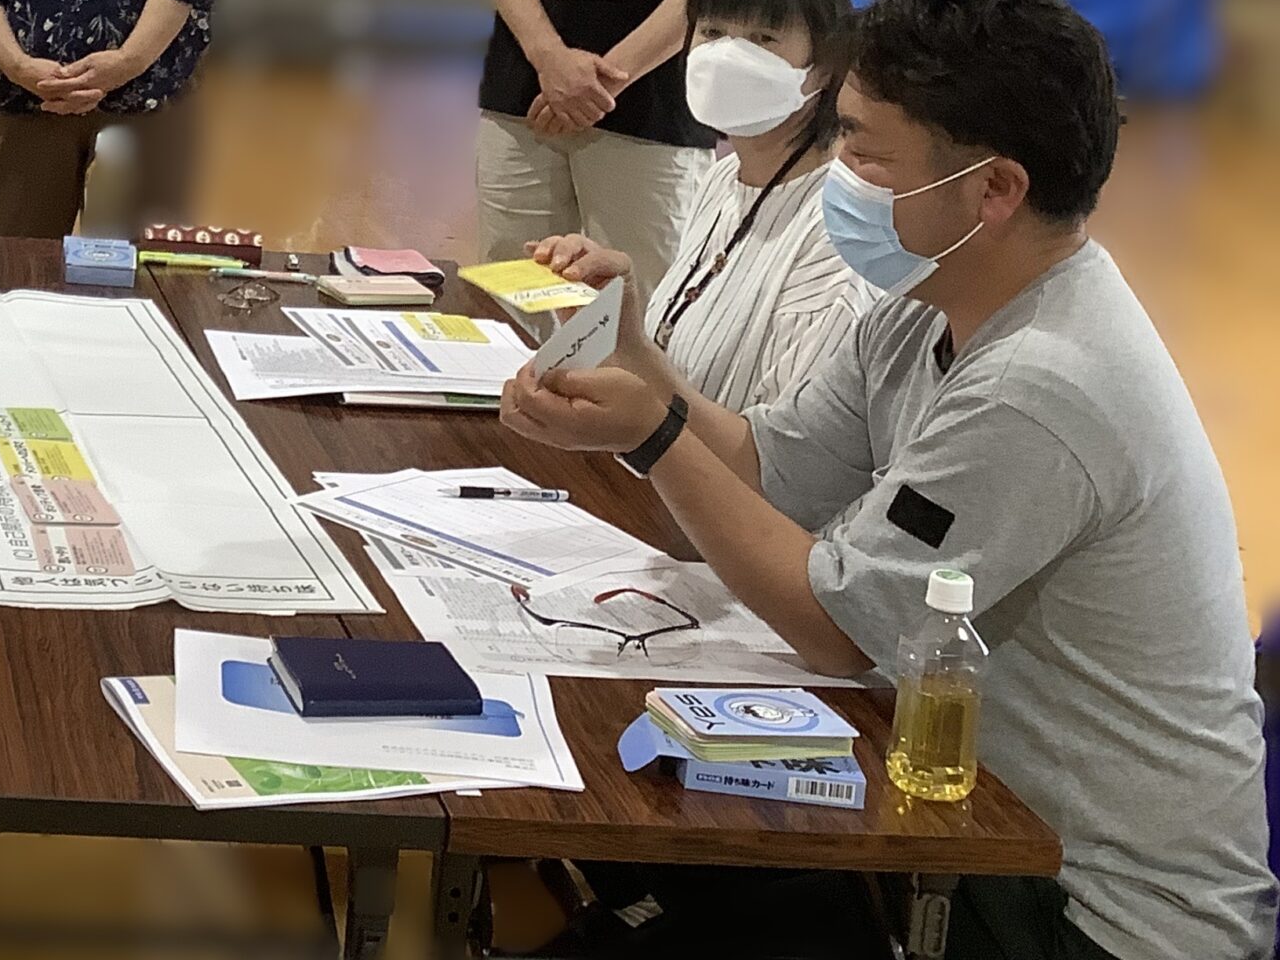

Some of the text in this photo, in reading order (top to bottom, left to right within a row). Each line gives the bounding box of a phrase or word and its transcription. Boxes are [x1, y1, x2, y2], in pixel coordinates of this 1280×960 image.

[723, 775, 776, 789] 持ち味カード
